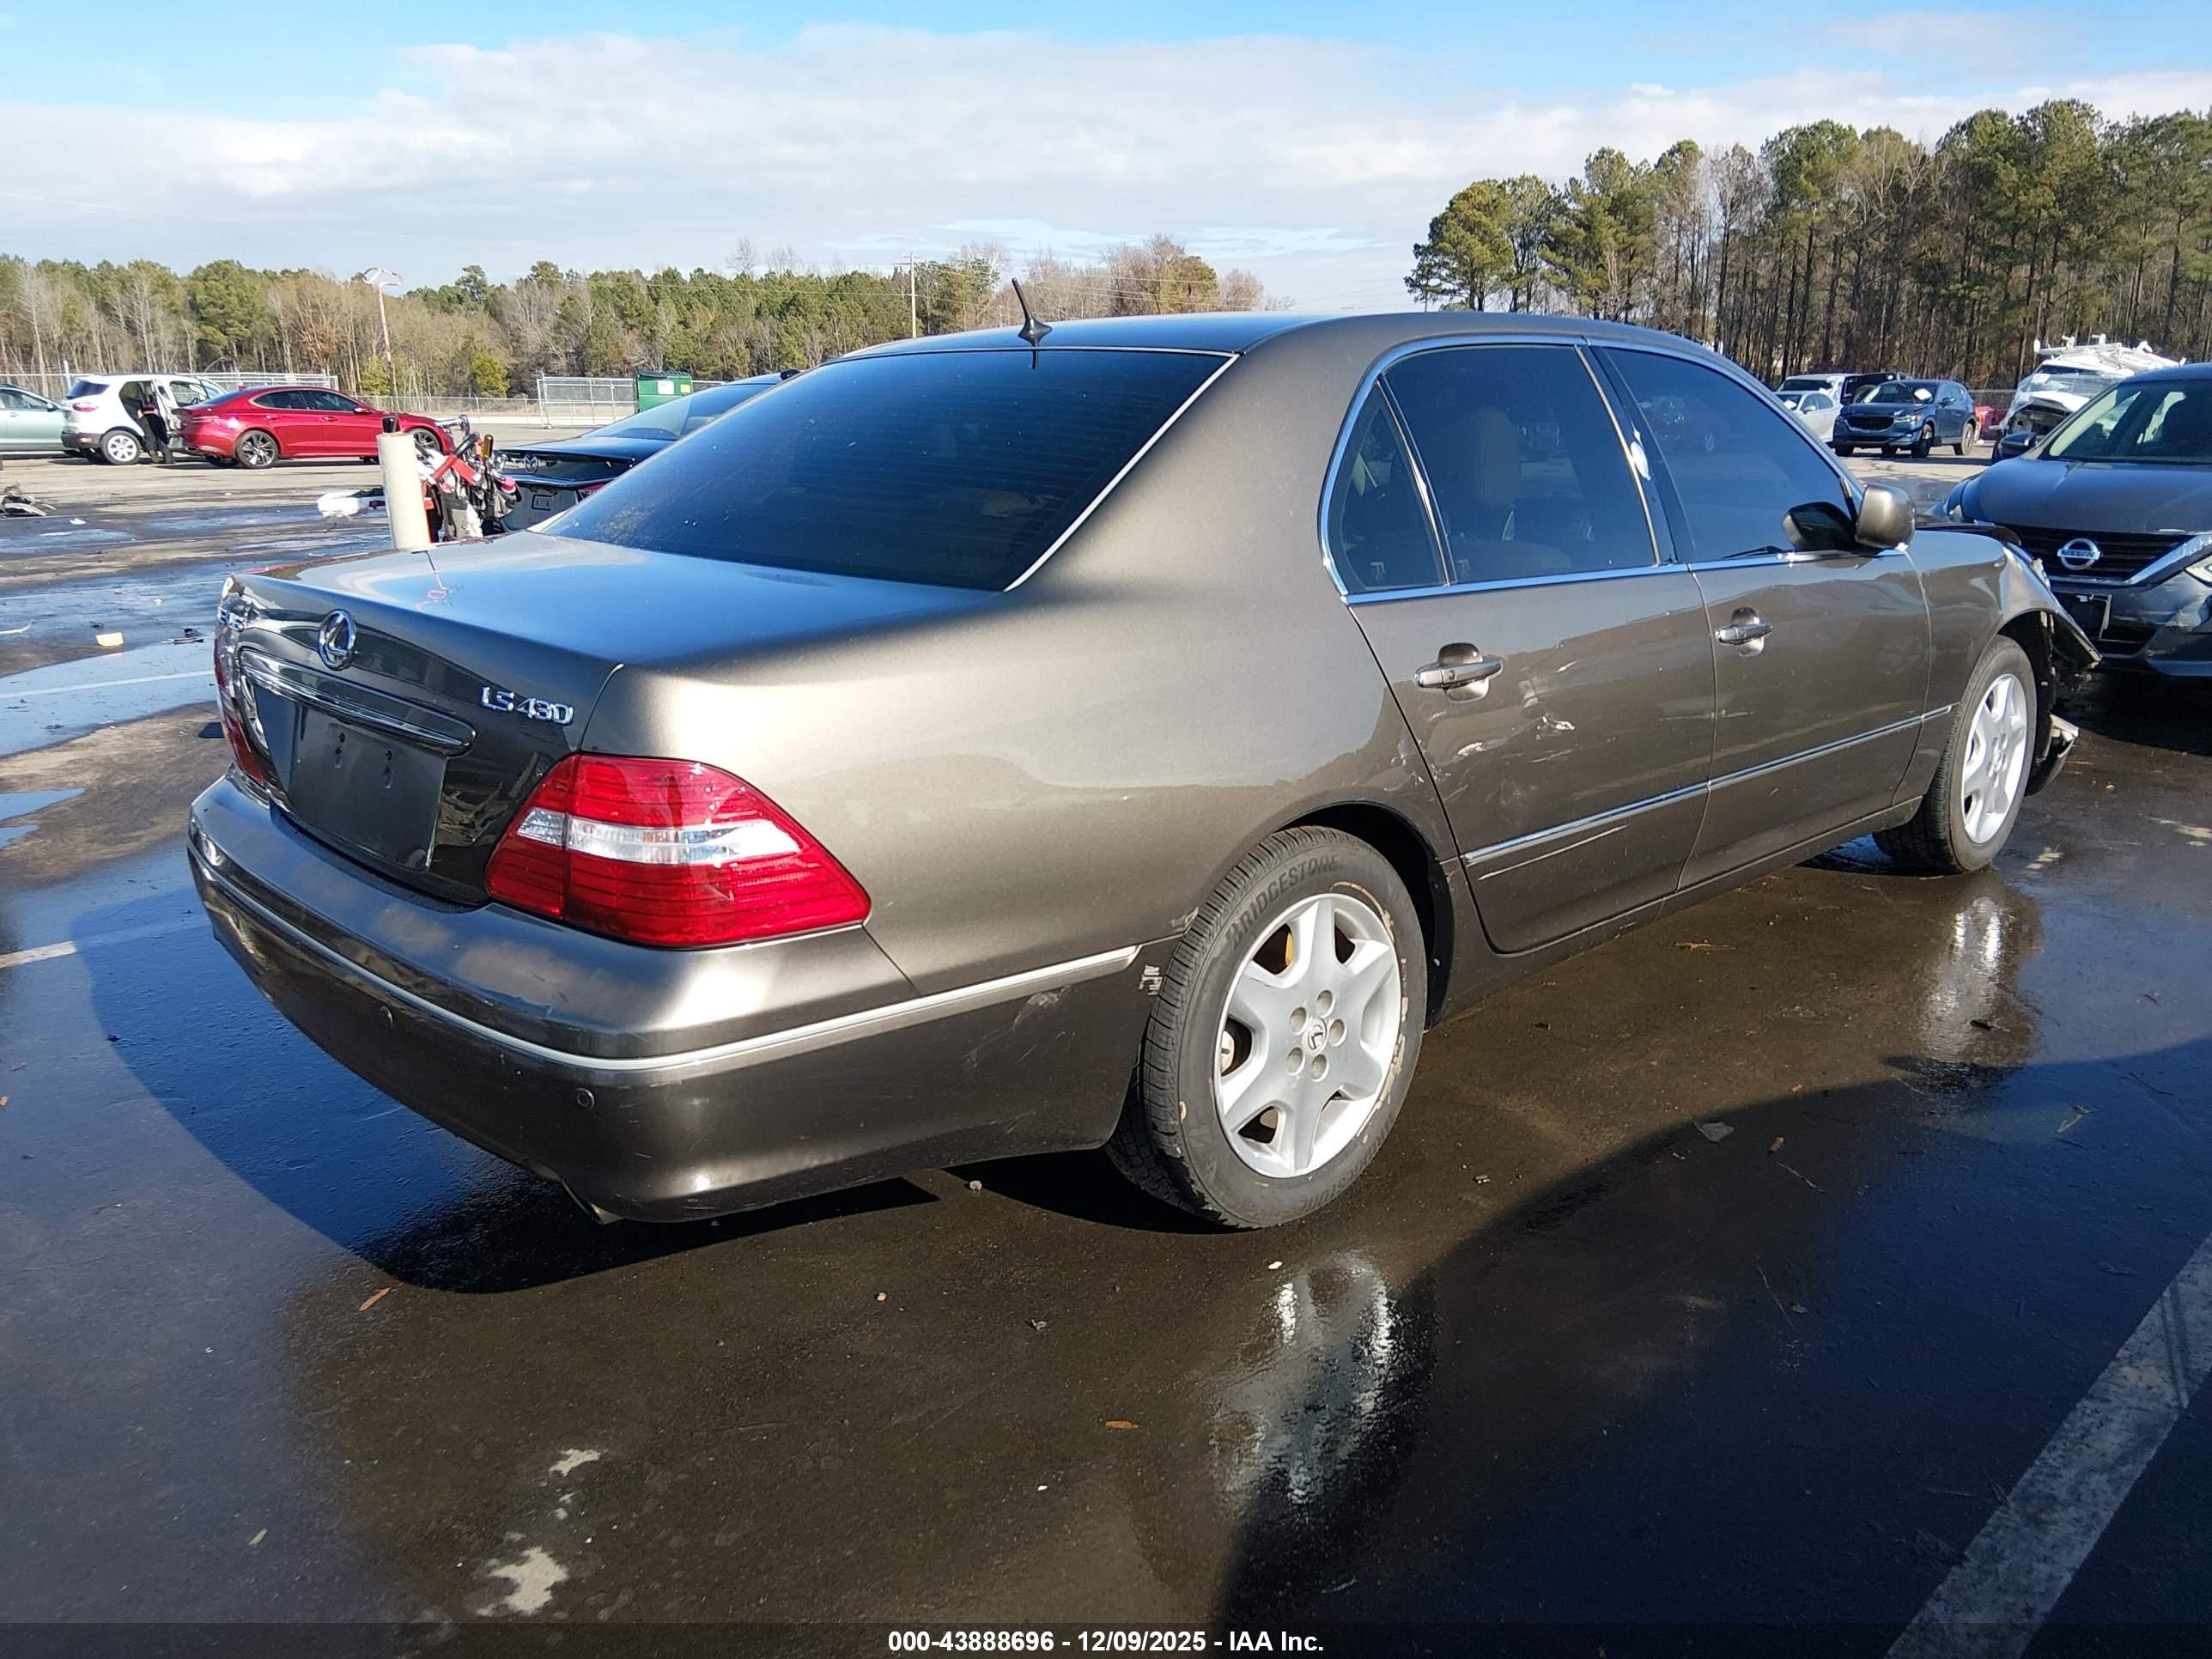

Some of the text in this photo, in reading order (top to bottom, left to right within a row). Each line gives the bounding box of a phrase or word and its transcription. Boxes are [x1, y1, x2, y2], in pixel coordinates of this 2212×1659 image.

[482, 686, 574, 725] LS 430
[1226, 854, 1339, 949] BRIDGESTONE
